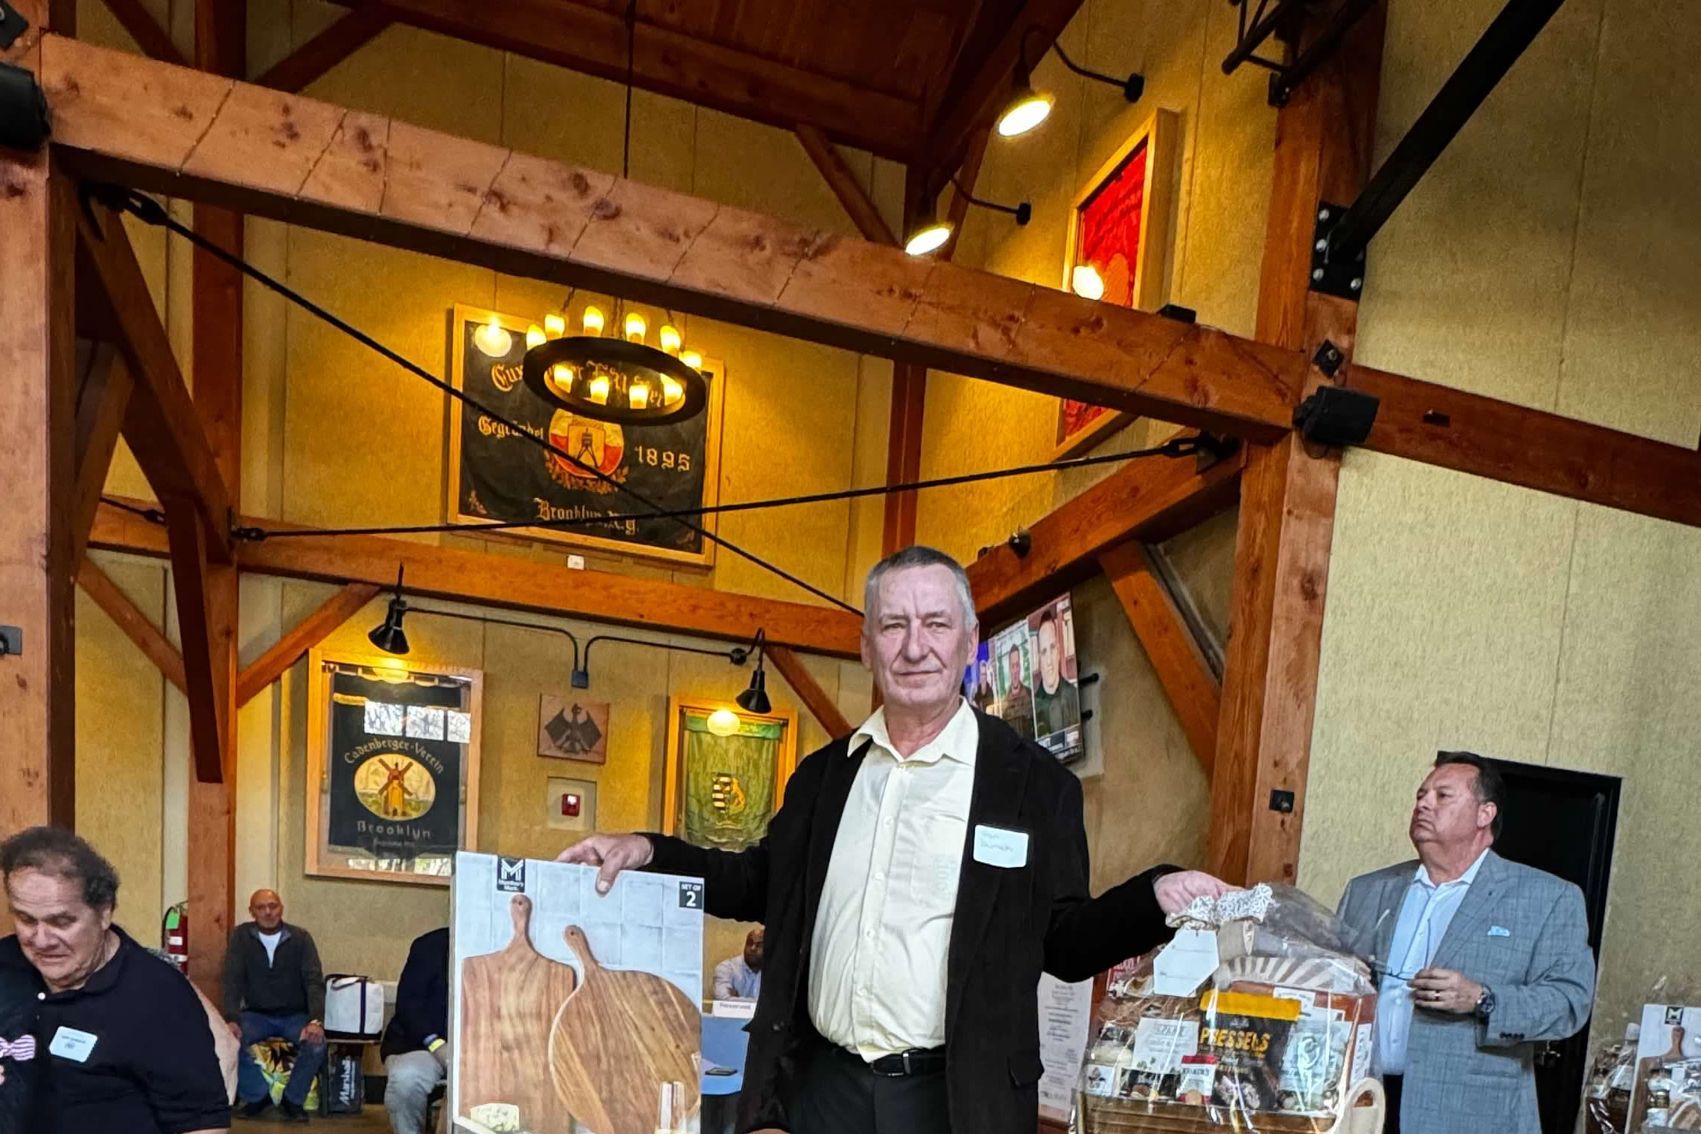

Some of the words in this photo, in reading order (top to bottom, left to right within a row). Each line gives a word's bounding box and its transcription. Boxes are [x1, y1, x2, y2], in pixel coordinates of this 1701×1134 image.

[635, 446, 691, 472] 1895
[356, 820, 431, 840] Brooklyn
[501, 859, 524, 880] M
[686, 891, 697, 907] 2
